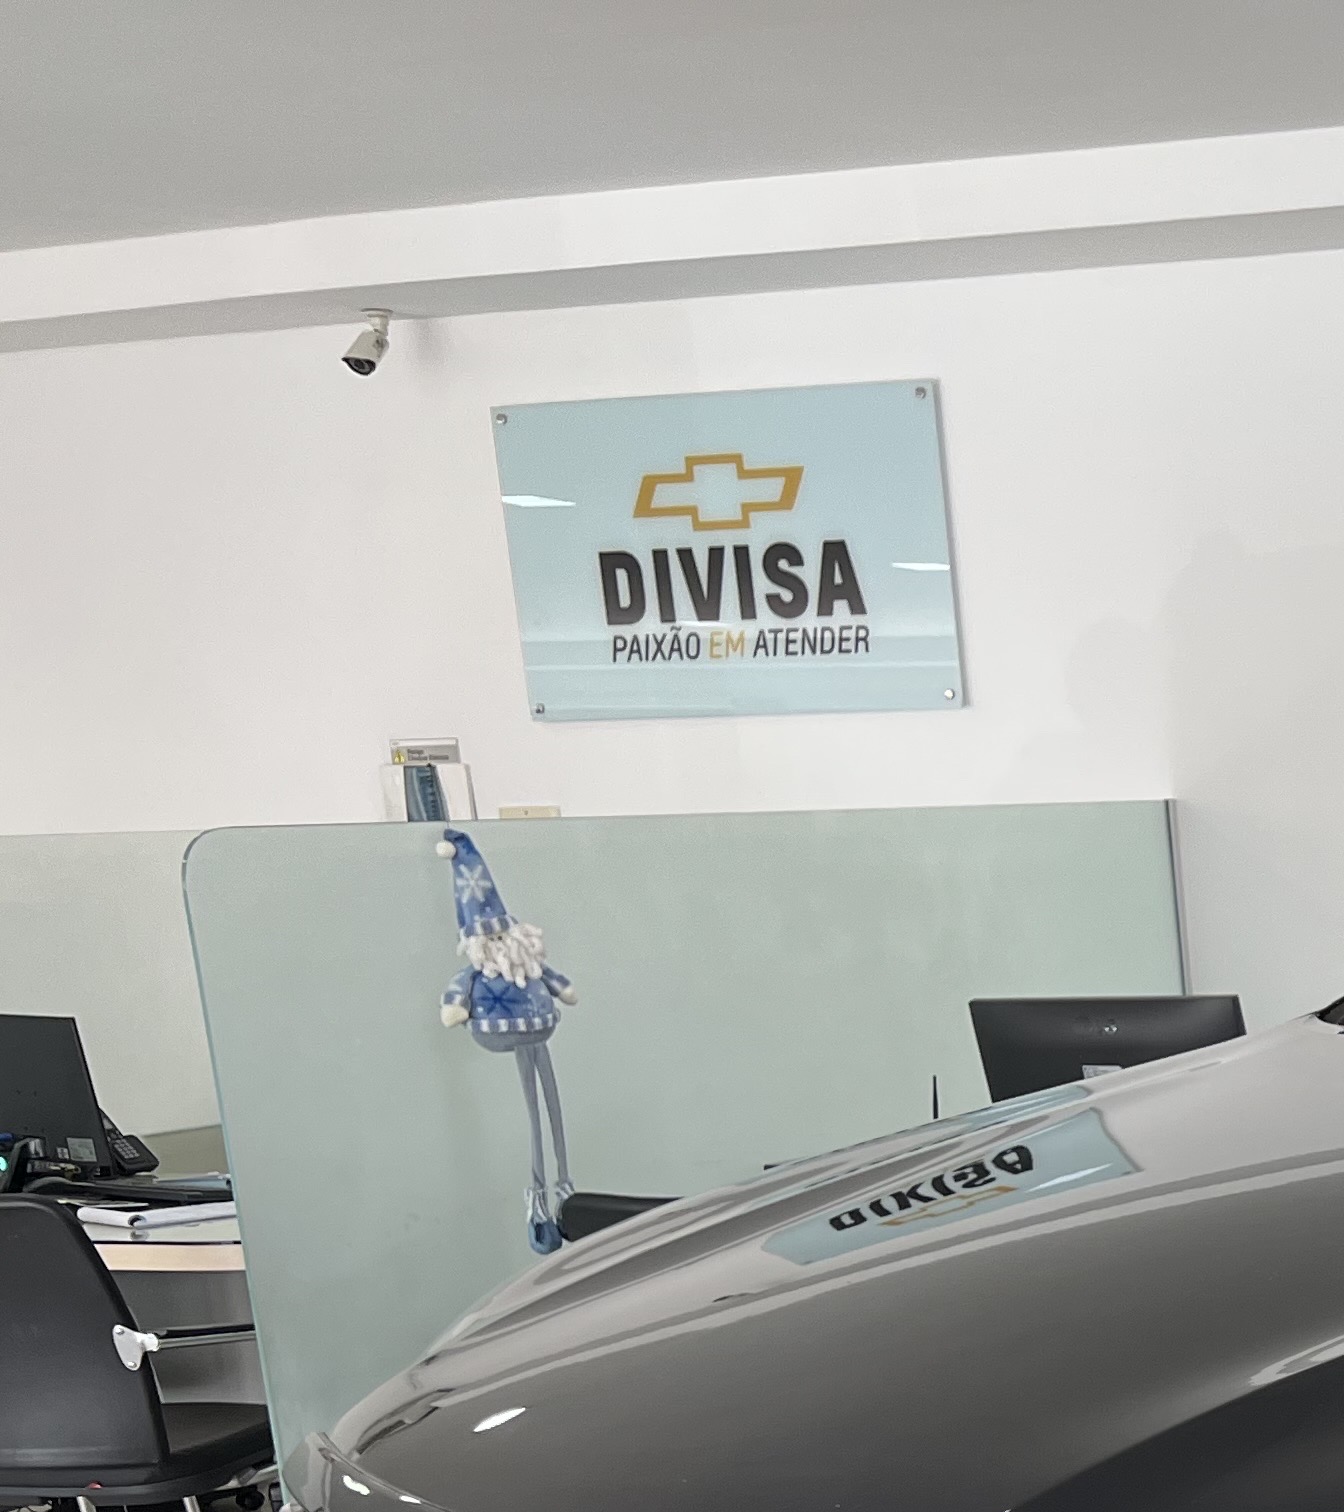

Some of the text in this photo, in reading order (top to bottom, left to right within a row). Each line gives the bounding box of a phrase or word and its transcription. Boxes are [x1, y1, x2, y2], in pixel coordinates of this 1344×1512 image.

[597, 539, 868, 625] DIVISA
[612, 625, 870, 662] PAIXÃO EM ATENDER
